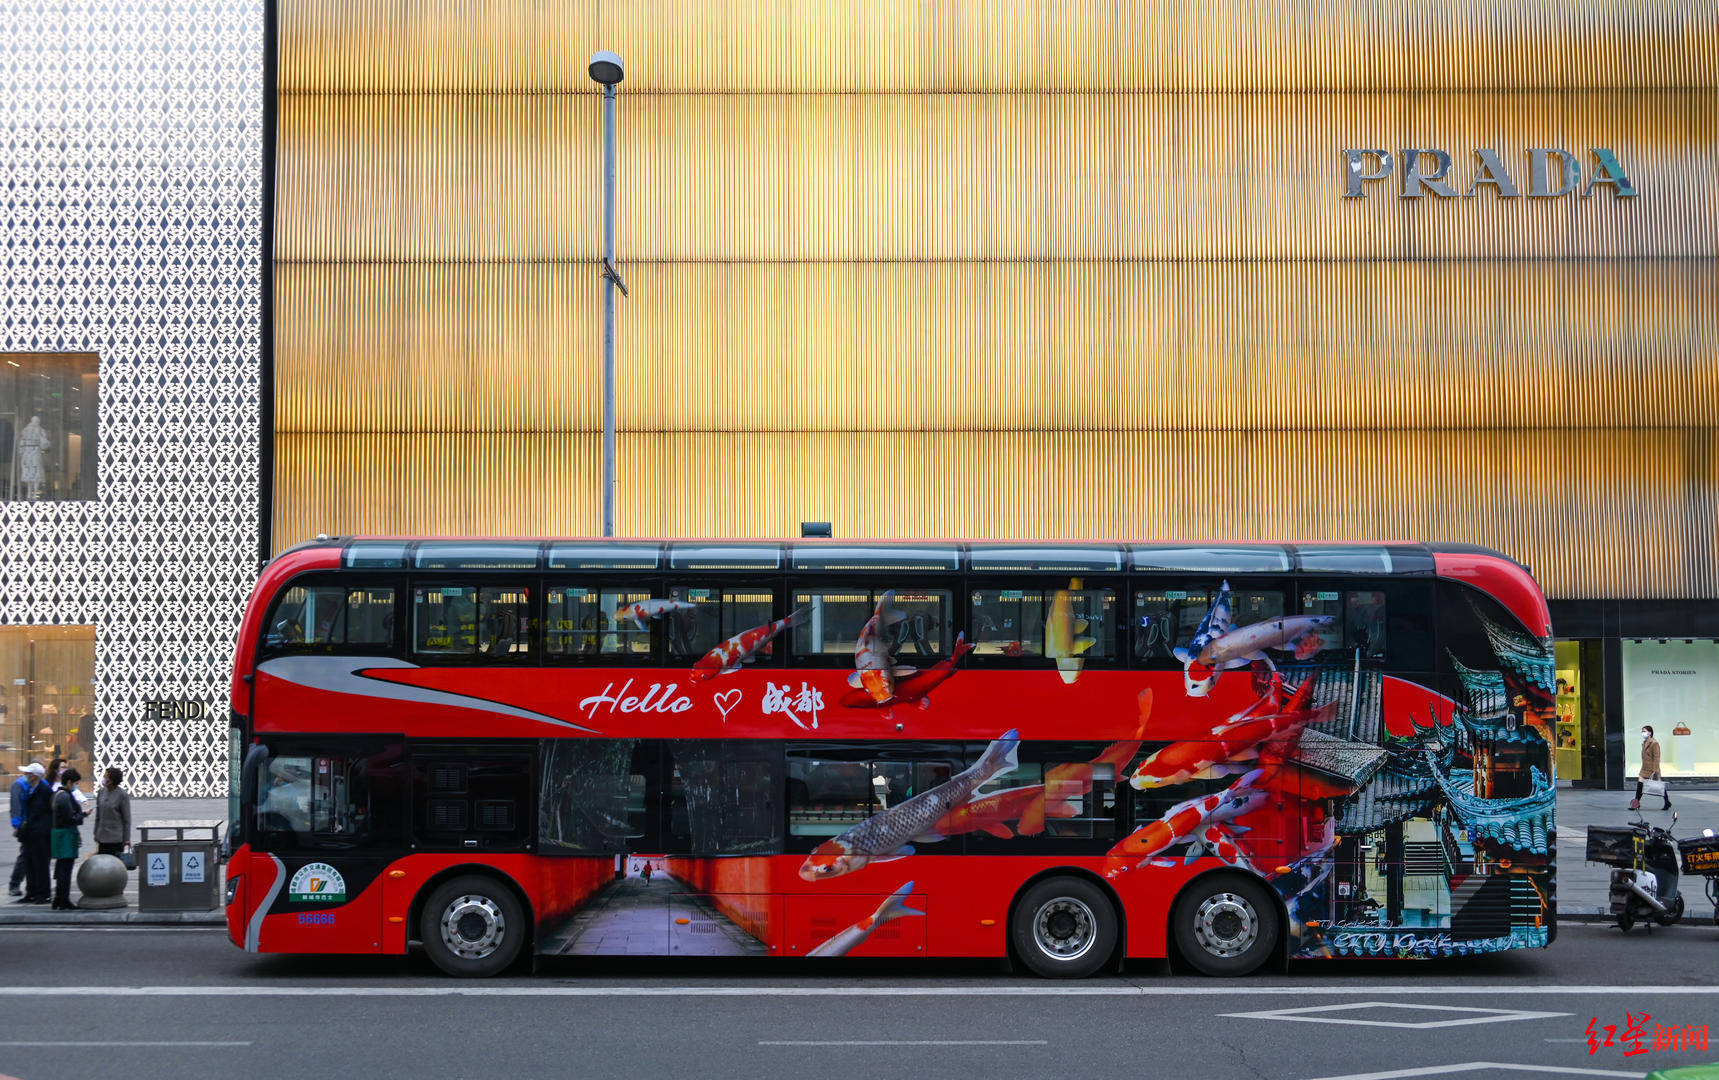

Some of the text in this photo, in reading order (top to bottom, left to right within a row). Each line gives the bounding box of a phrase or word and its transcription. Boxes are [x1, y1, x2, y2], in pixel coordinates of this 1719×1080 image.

[1341, 148, 1639, 198] PRADA
[146, 701, 206, 719] FENDI
[579, 677, 694, 720] Hello
[761, 681, 825, 730] 成都
[298, 913, 336, 925] 56666
